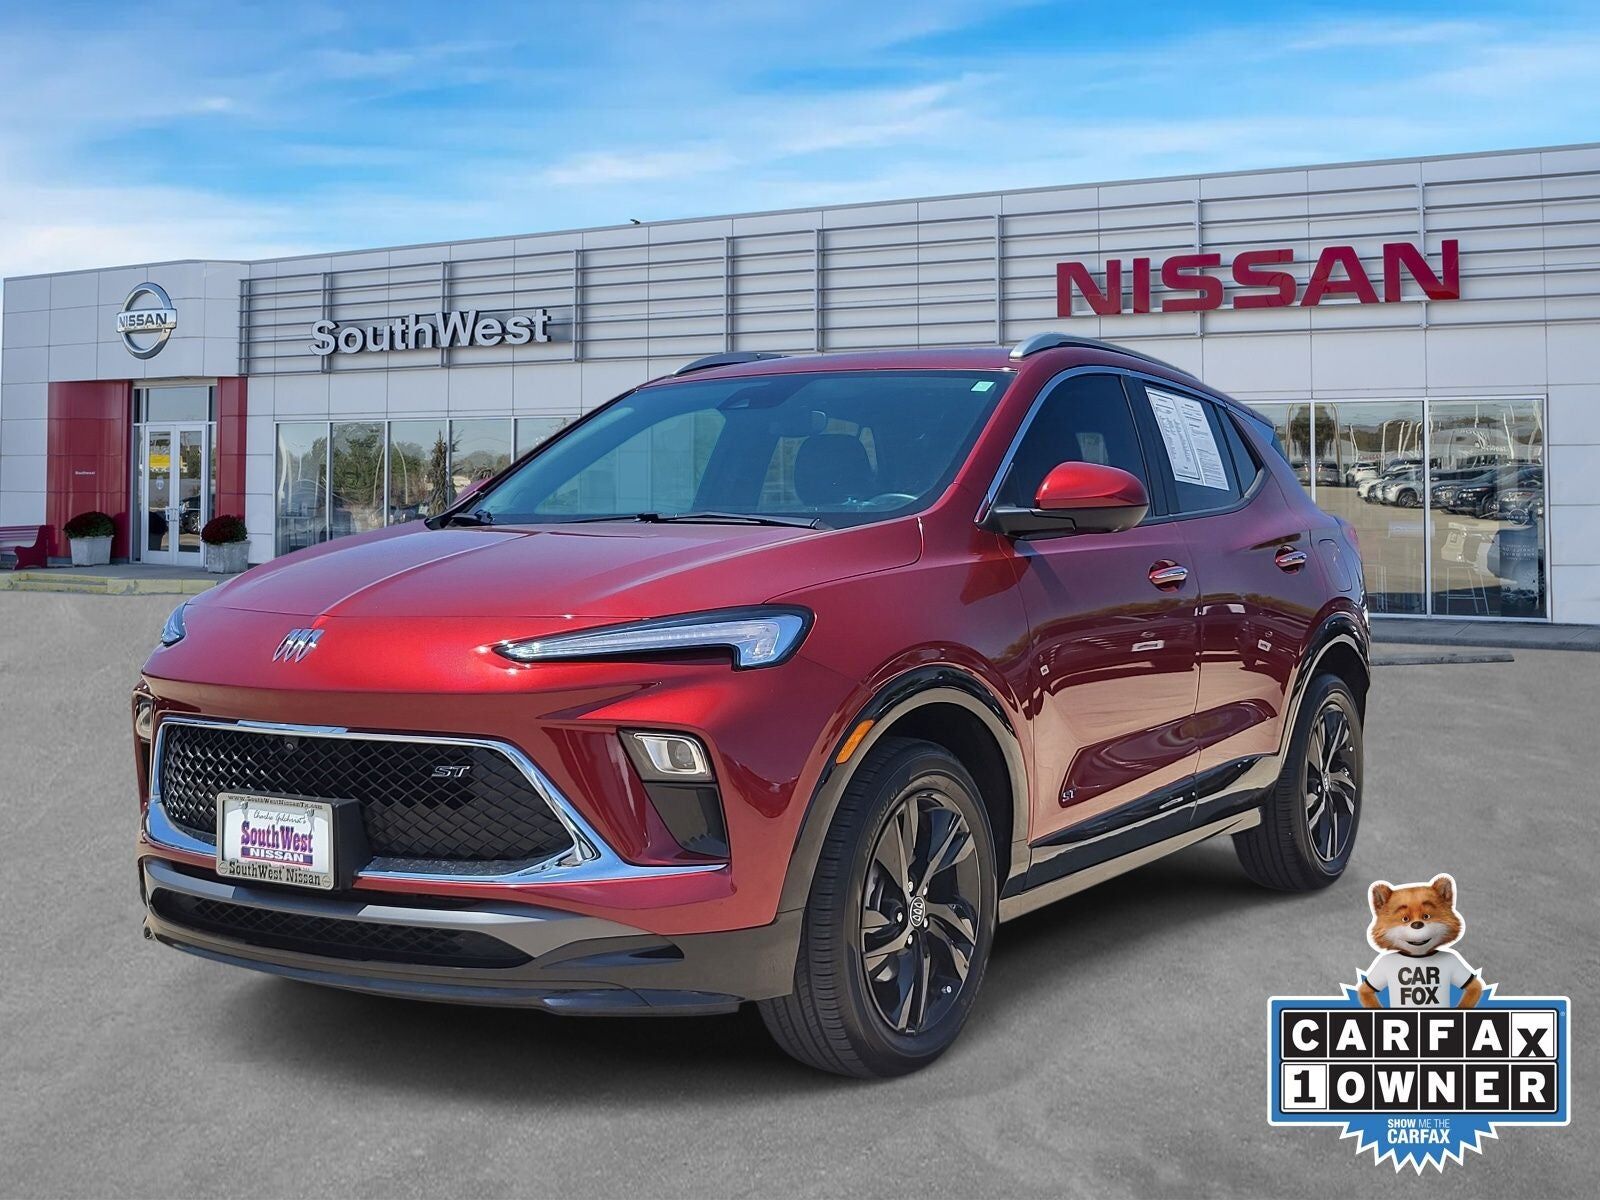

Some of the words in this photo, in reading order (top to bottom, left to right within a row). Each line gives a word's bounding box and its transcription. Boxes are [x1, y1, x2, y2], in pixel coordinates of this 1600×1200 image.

[1056, 239, 1460, 319] NISSAN
[119, 312, 168, 329] NISSAN
[309, 308, 552, 356] SouthWest
[431, 765, 470, 778] ST
[240, 820, 314, 853] SouthWest
[249, 847, 304, 862] NISSAN
[229, 860, 283, 881] SouthWest
[285, 868, 321, 886] Nissan
